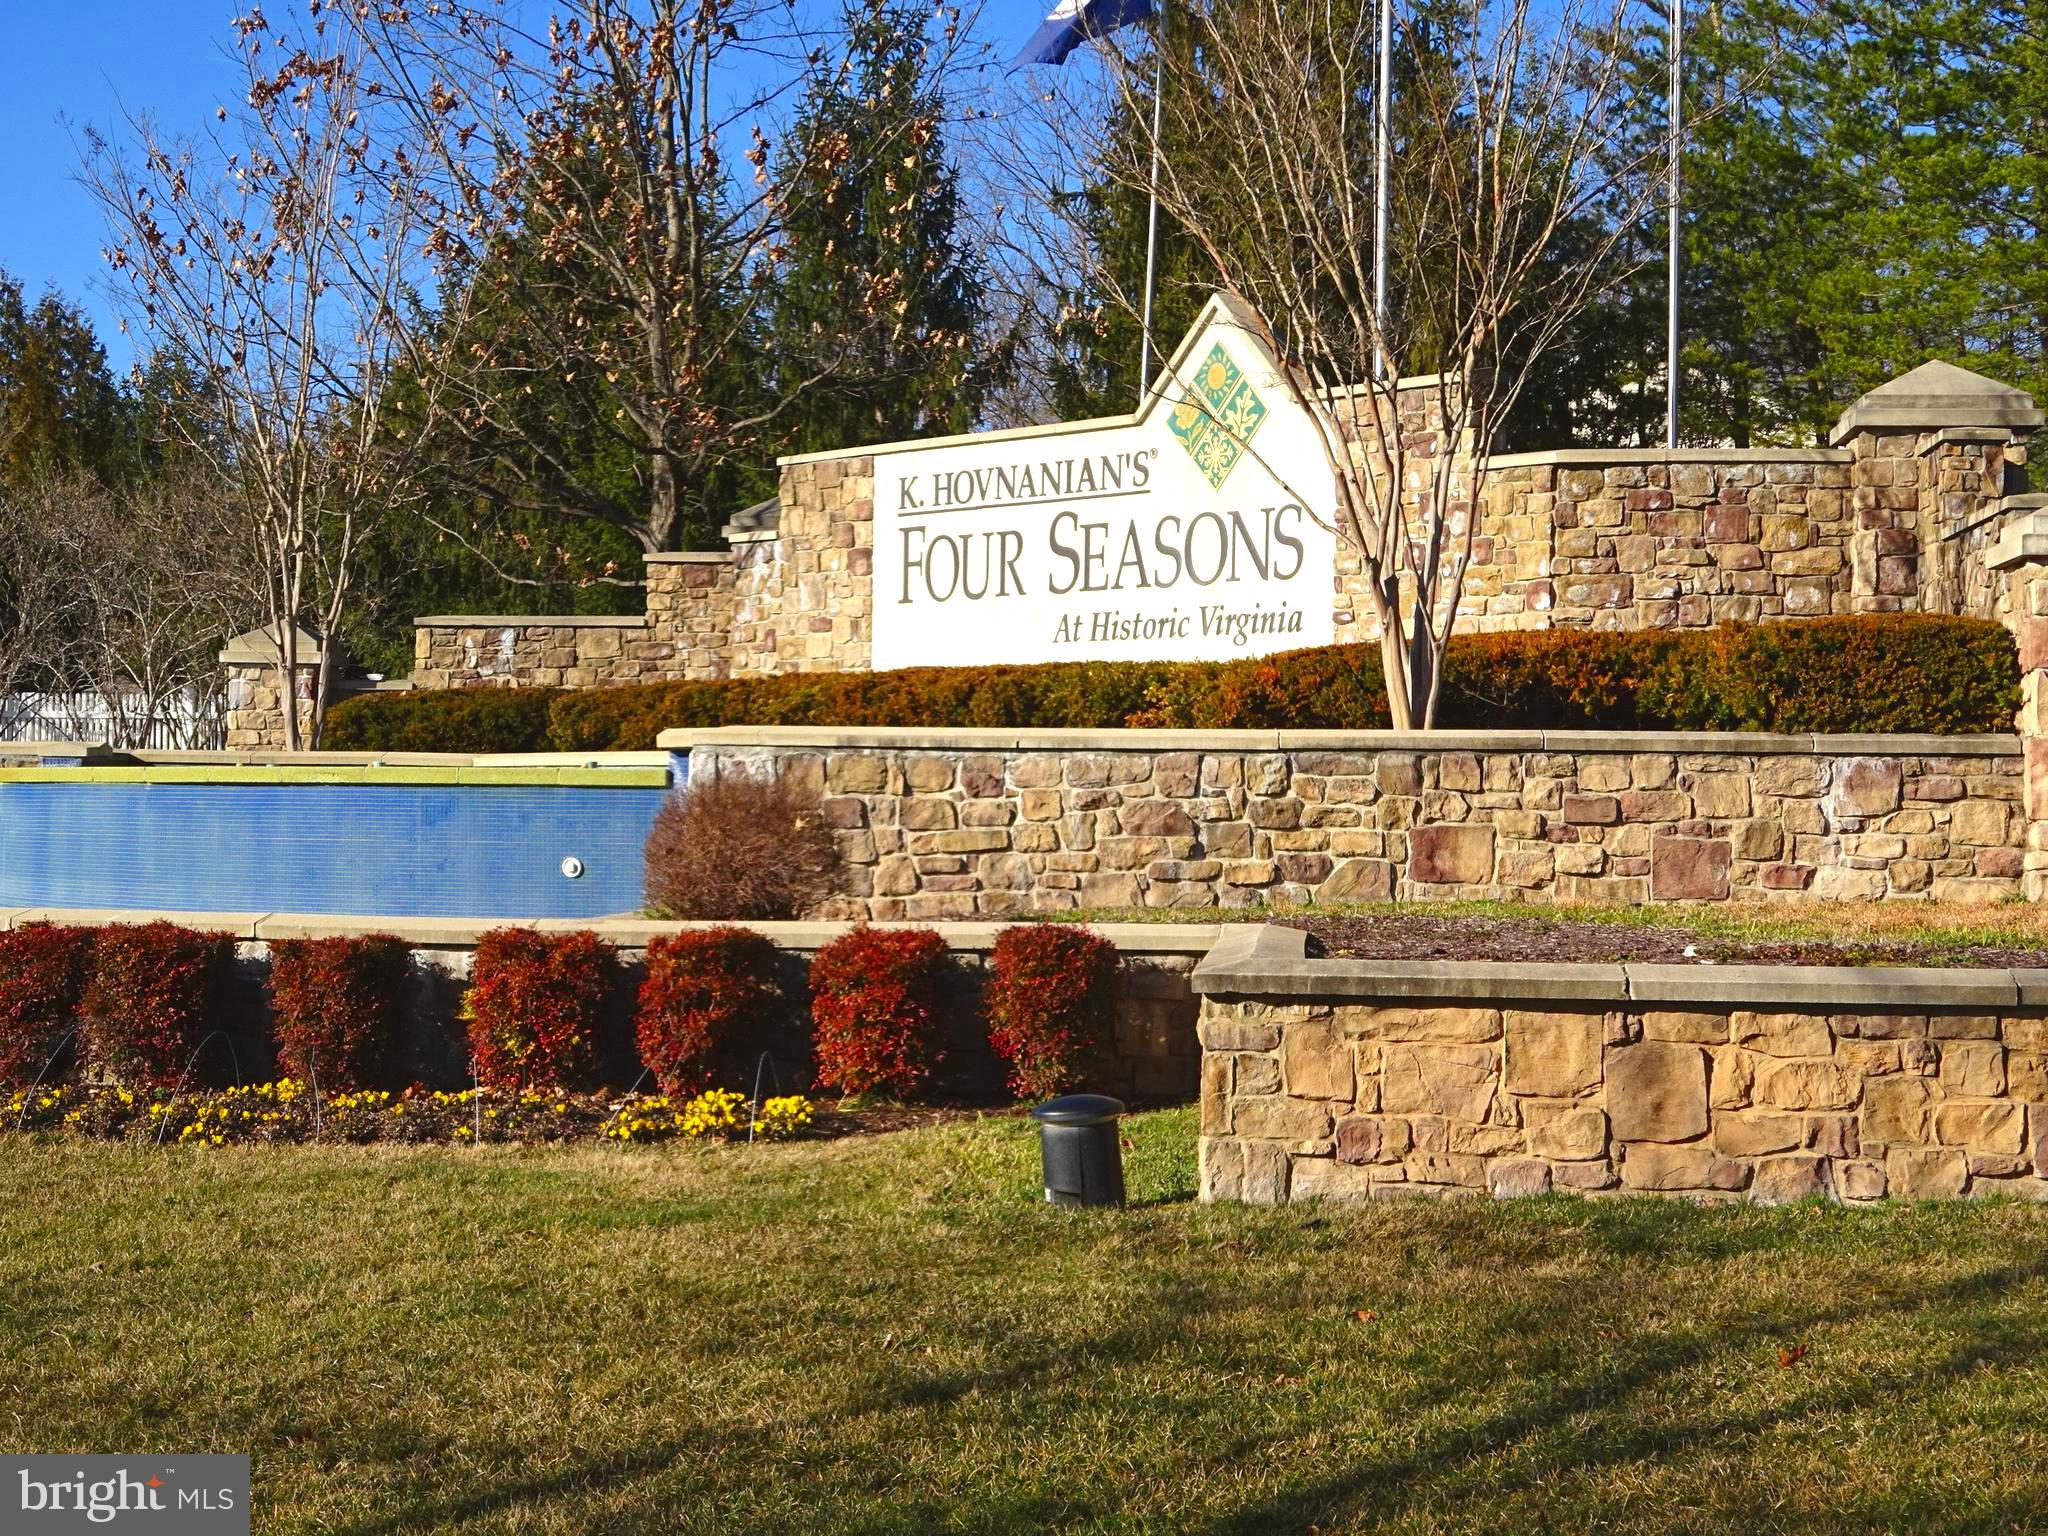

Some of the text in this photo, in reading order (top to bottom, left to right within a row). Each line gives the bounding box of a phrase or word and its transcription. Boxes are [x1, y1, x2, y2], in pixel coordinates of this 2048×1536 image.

[898, 475, 925, 510] K.
[897, 503, 1305, 604] FOUR SEASONS
[1053, 600, 1304, 647] At Historic Virginia
